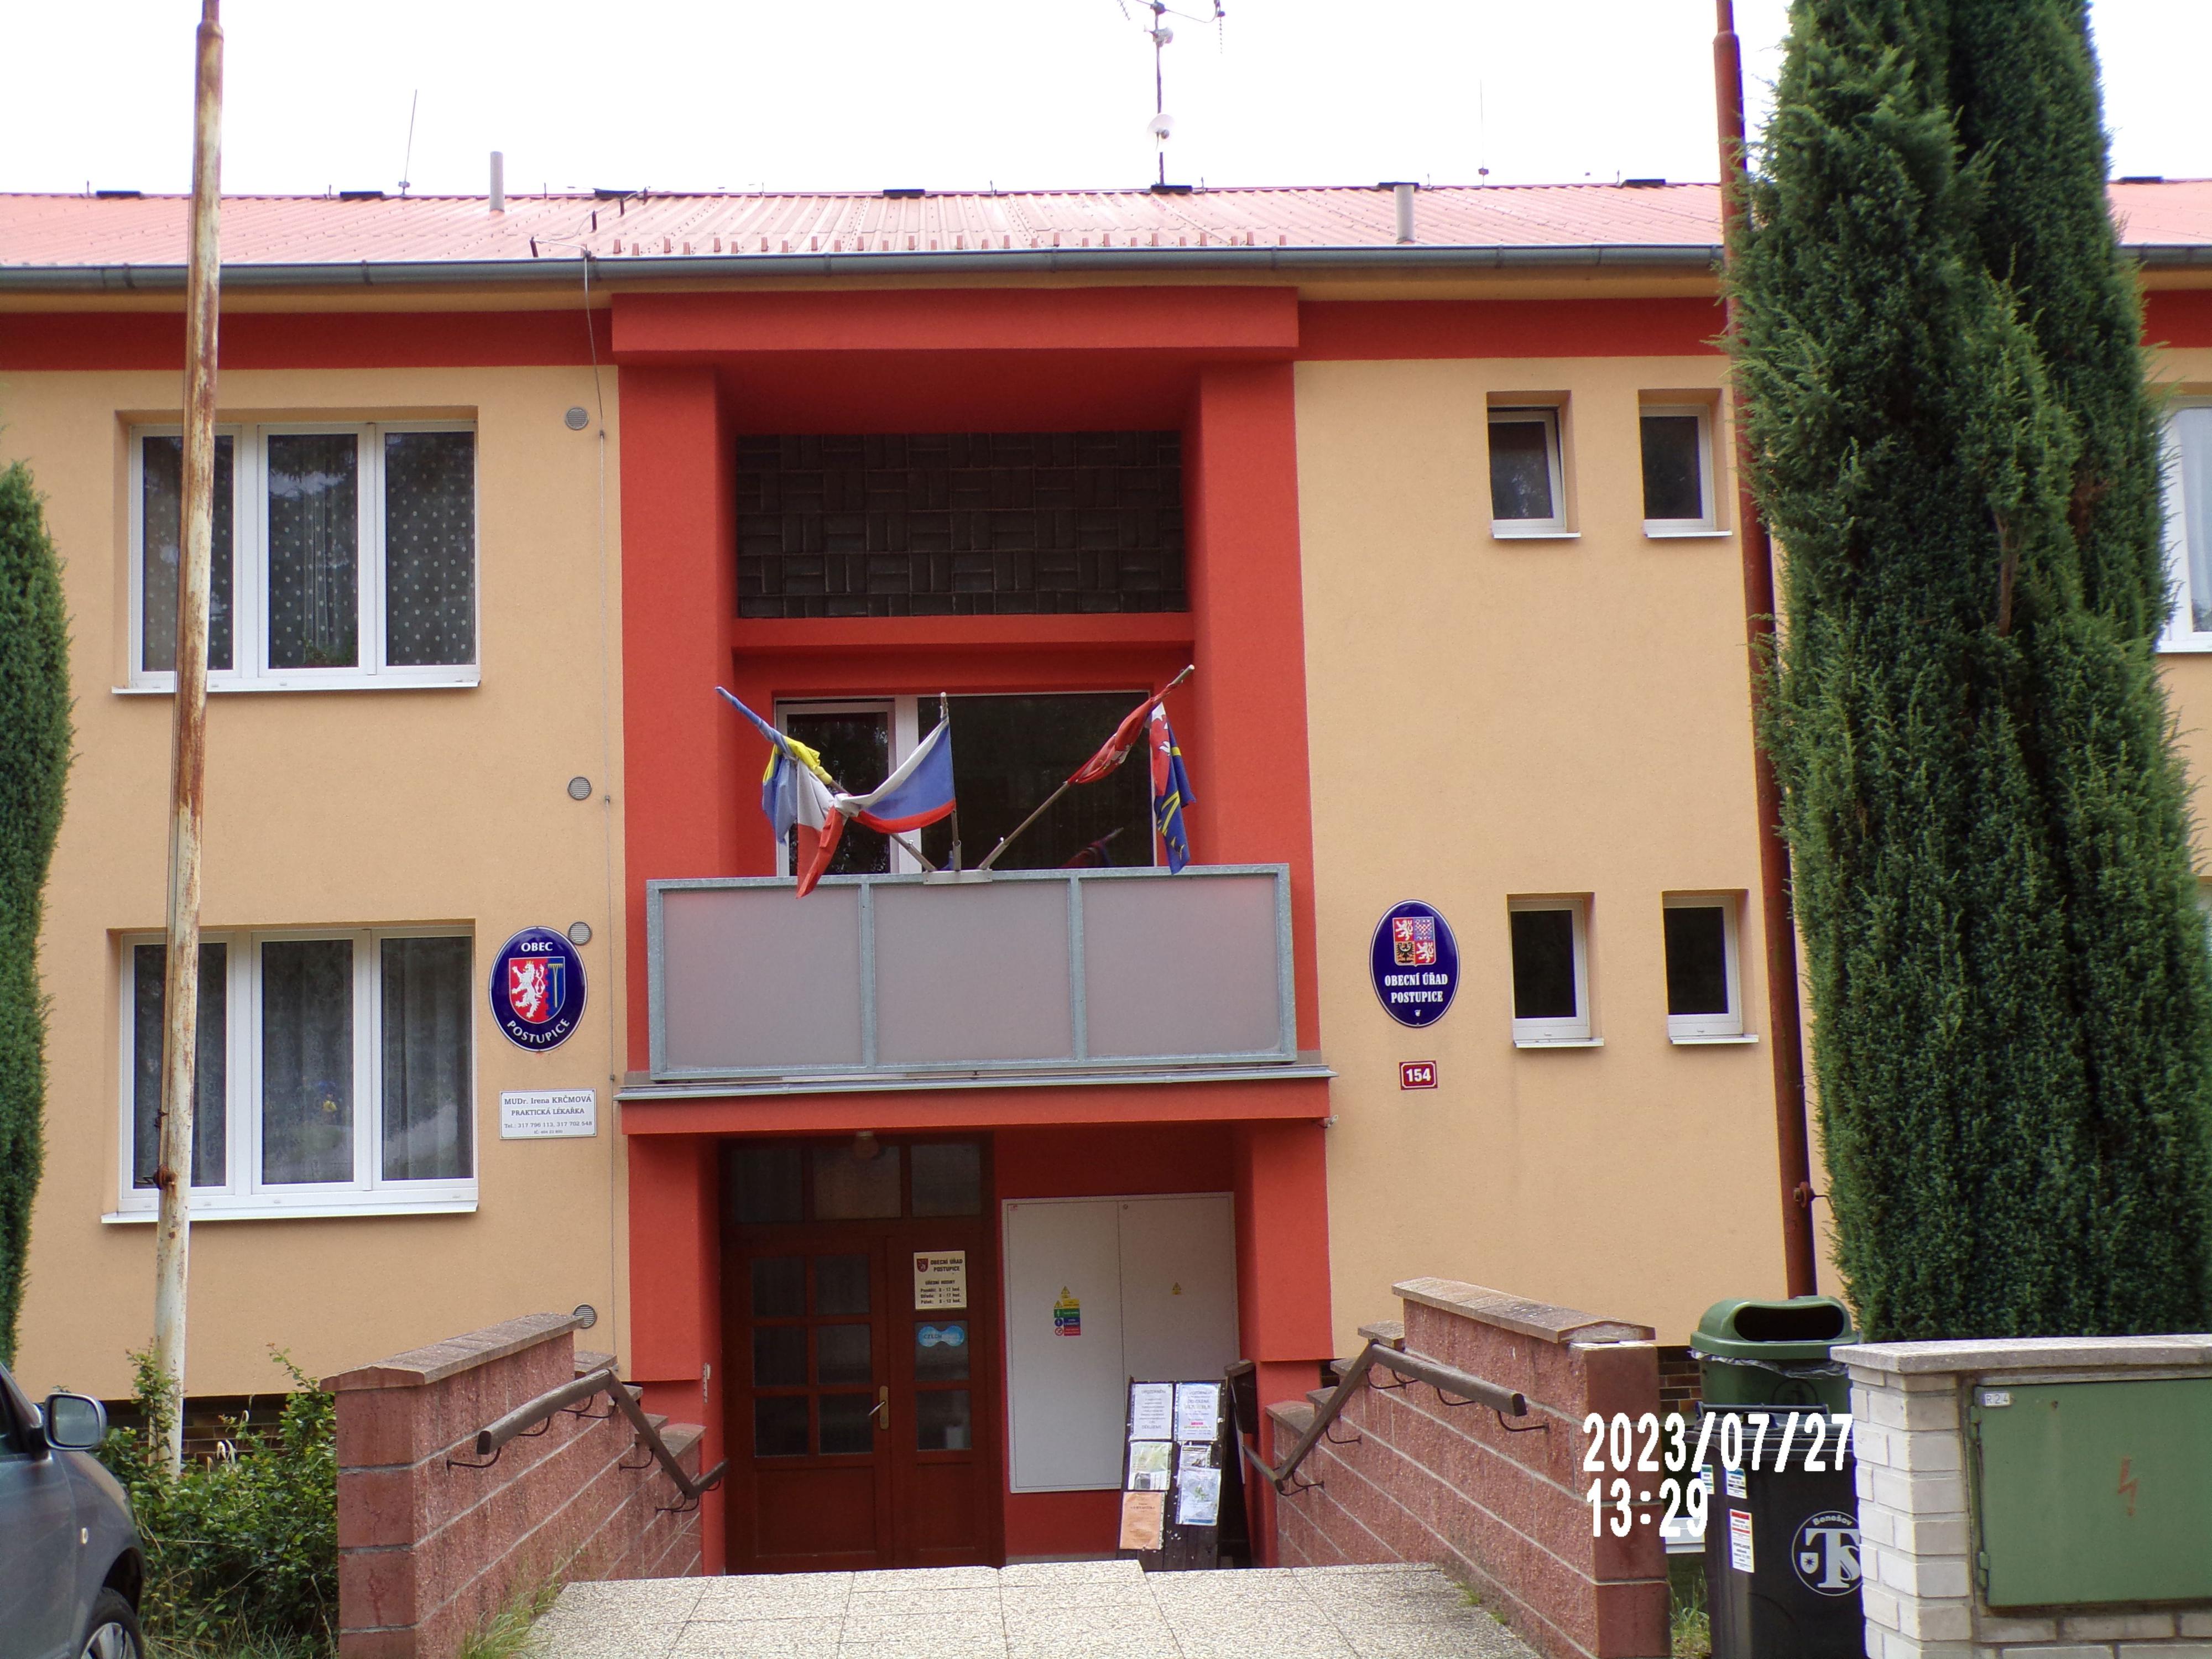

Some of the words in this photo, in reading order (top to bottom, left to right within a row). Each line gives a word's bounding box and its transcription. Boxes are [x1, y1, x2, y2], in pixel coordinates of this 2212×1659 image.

[521, 942, 553, 952] OBEC
[1384, 973, 1420, 987] OBECNÍ
[1422, 972, 1448, 985] ÚŘAD
[1391, 990, 1443, 1004] POSTUPICE
[507, 1018, 570, 1044] POSTUPICE
[1406, 1068, 1431, 1082] 154
[552, 1094, 592, 1103] KRČMOVÁ
[512, 1107, 551, 1116] PRAKTICKÁ
